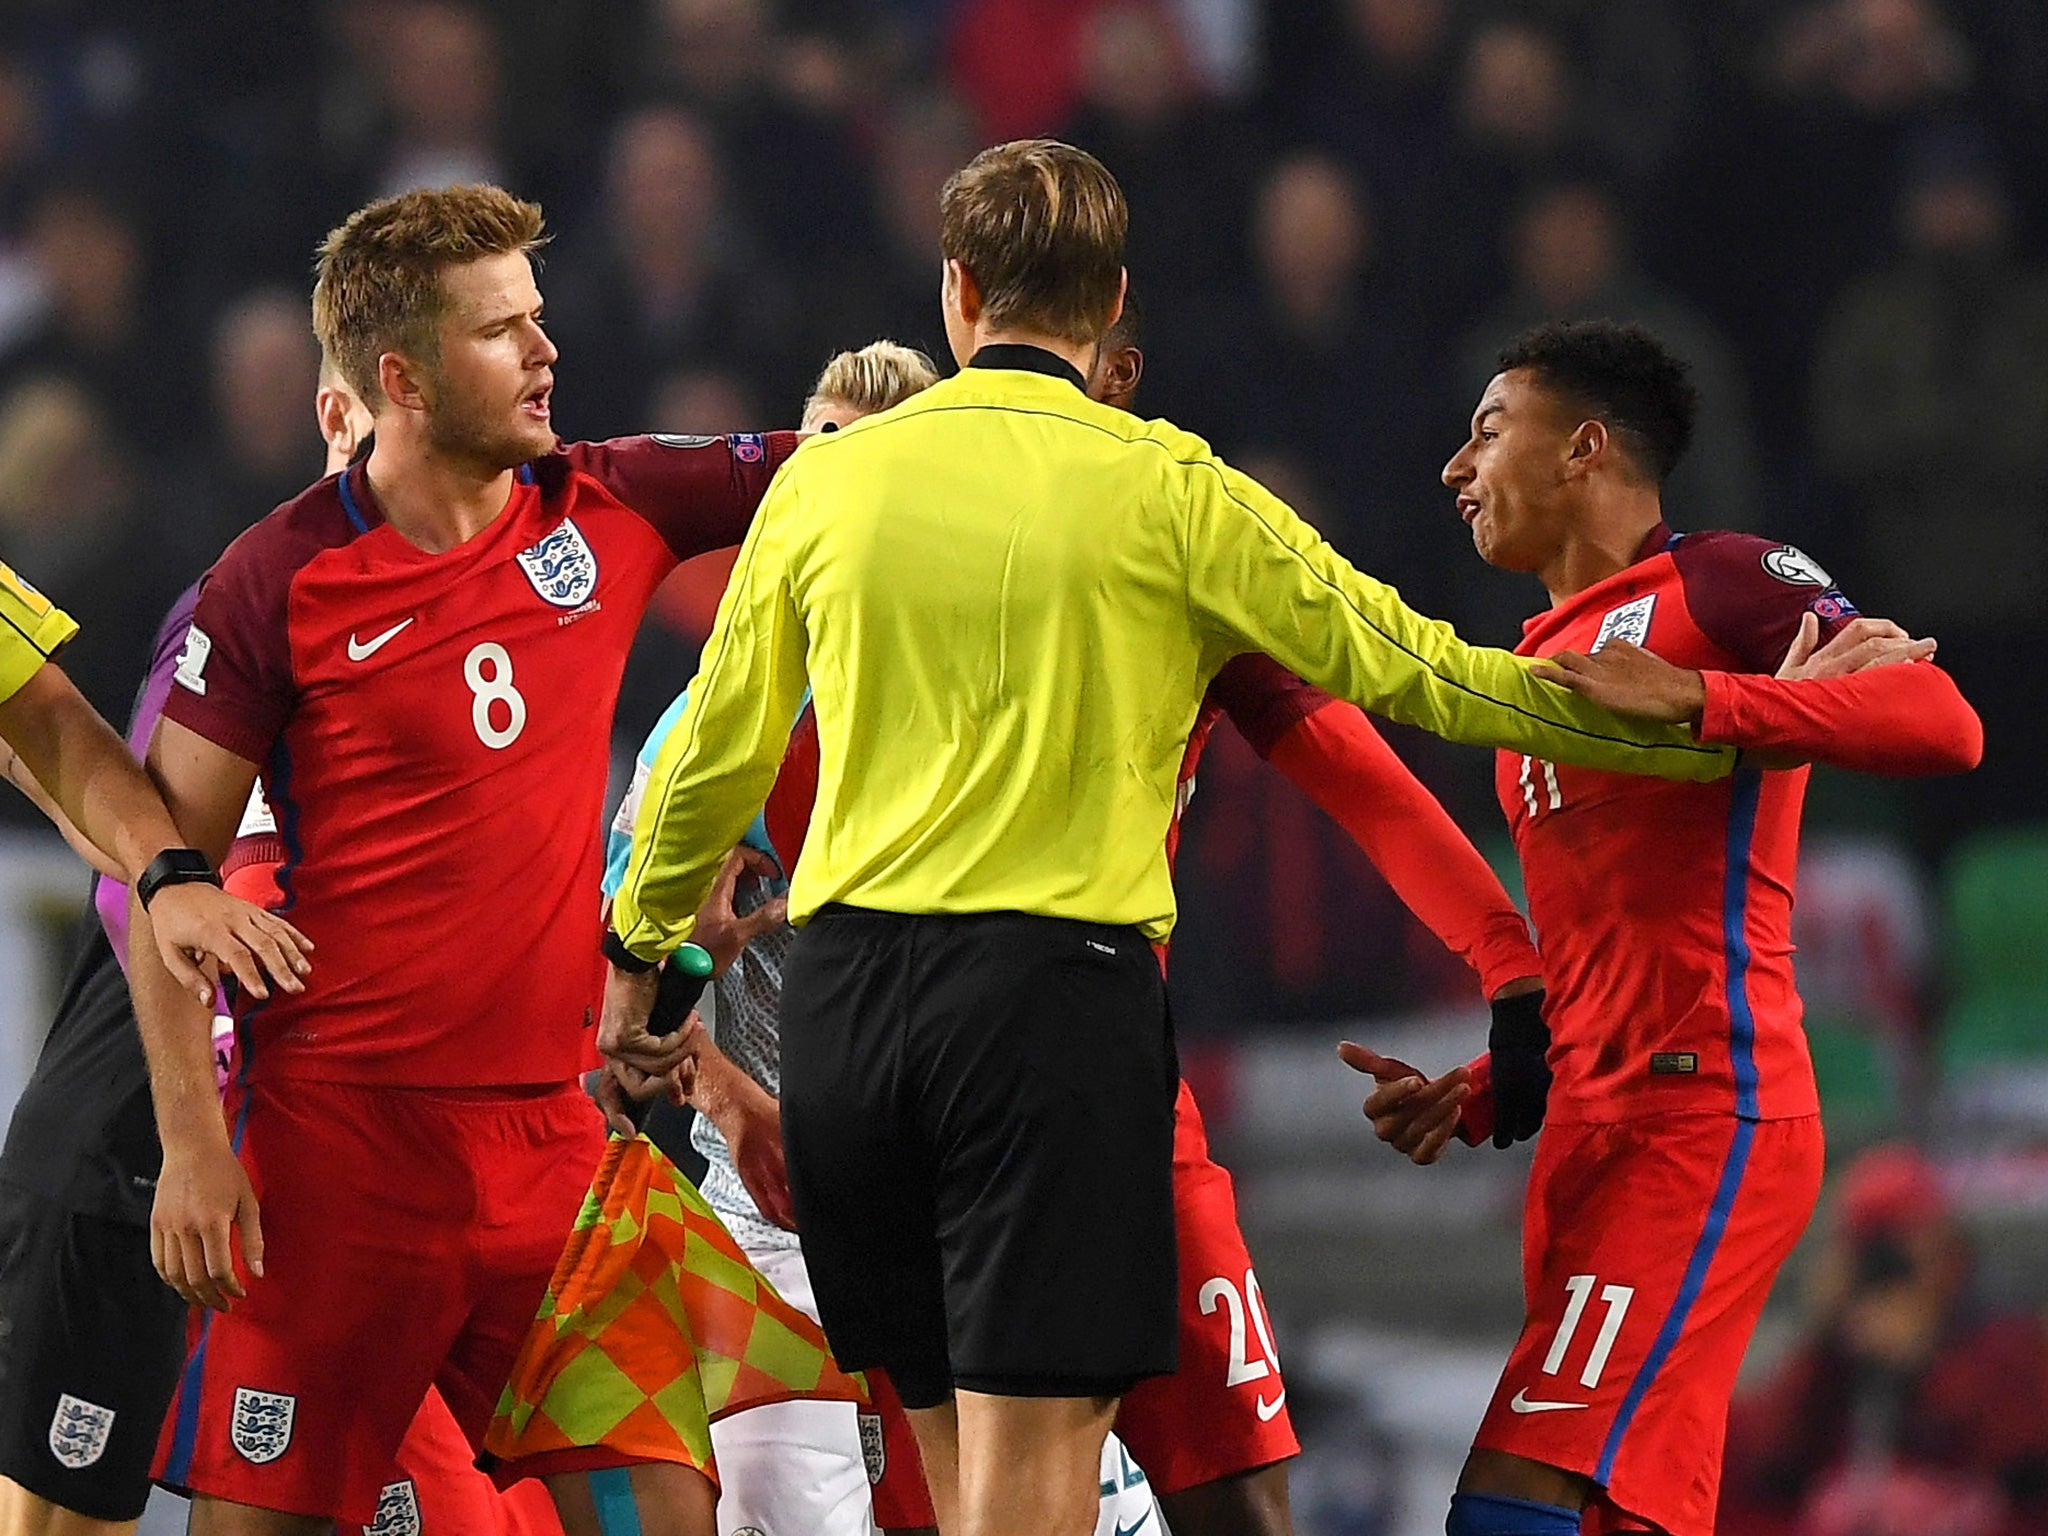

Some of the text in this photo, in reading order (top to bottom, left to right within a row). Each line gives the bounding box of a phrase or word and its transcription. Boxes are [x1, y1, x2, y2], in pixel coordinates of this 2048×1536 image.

[463, 642, 526, 749] 8
[1199, 1268, 1280, 1387] 20
[1542, 1275, 1635, 1389] 11
